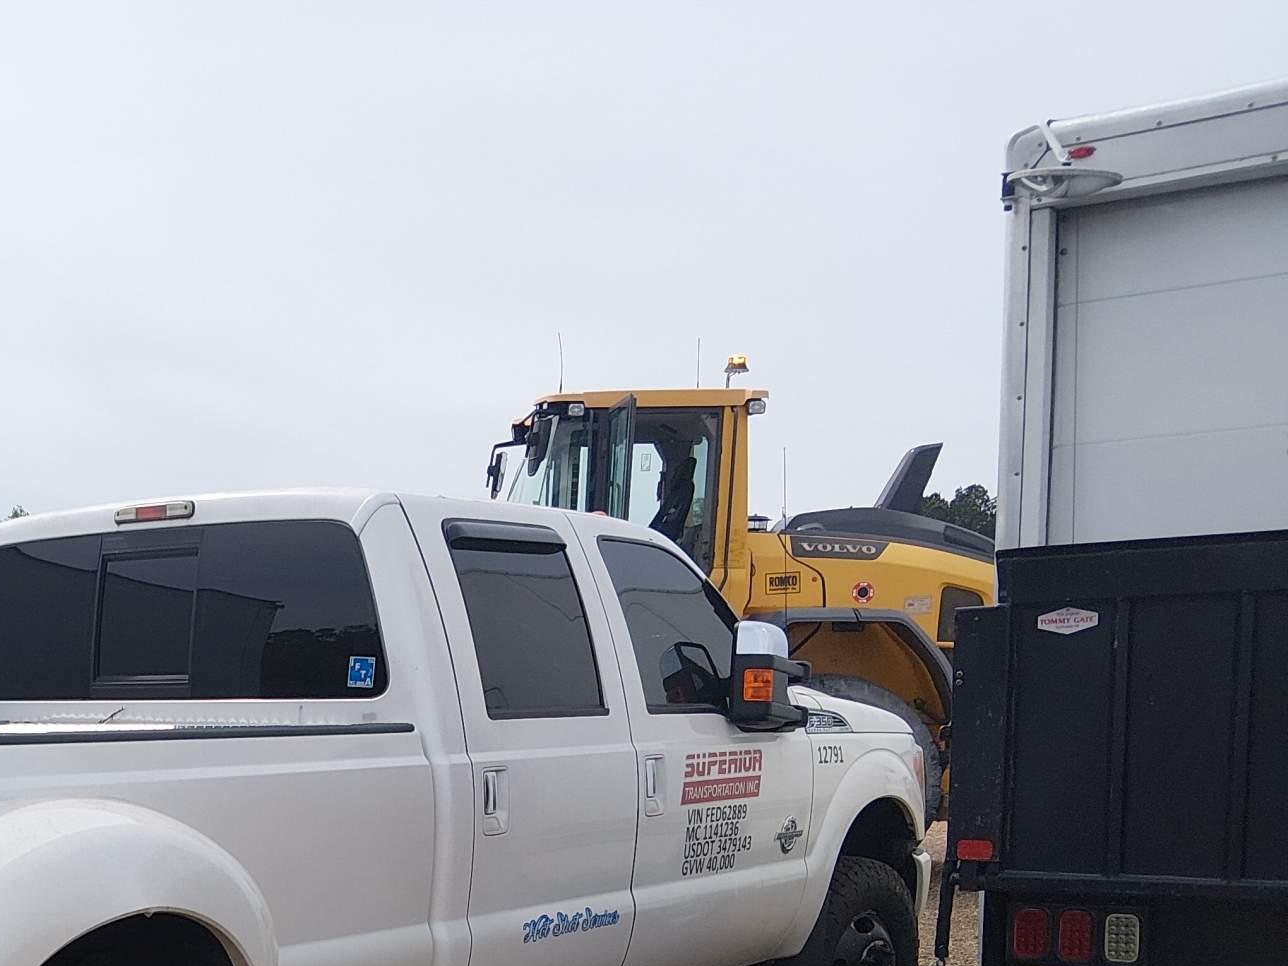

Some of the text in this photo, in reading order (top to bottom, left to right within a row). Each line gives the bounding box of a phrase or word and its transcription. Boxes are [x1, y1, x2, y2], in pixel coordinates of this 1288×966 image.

[800, 543, 876, 554] VOLVO
[684, 749, 763, 778] SUPERIOR
[818, 746, 844, 764] 12791
[685, 780, 759, 800] TRANSPORTATION INC
[687, 804, 747, 825] VIN FED62889
[685, 821, 739, 842] MC 1141236
[684, 836, 752, 860] USDOT 3479143
[682, 854, 734, 876] GVW 40,000
